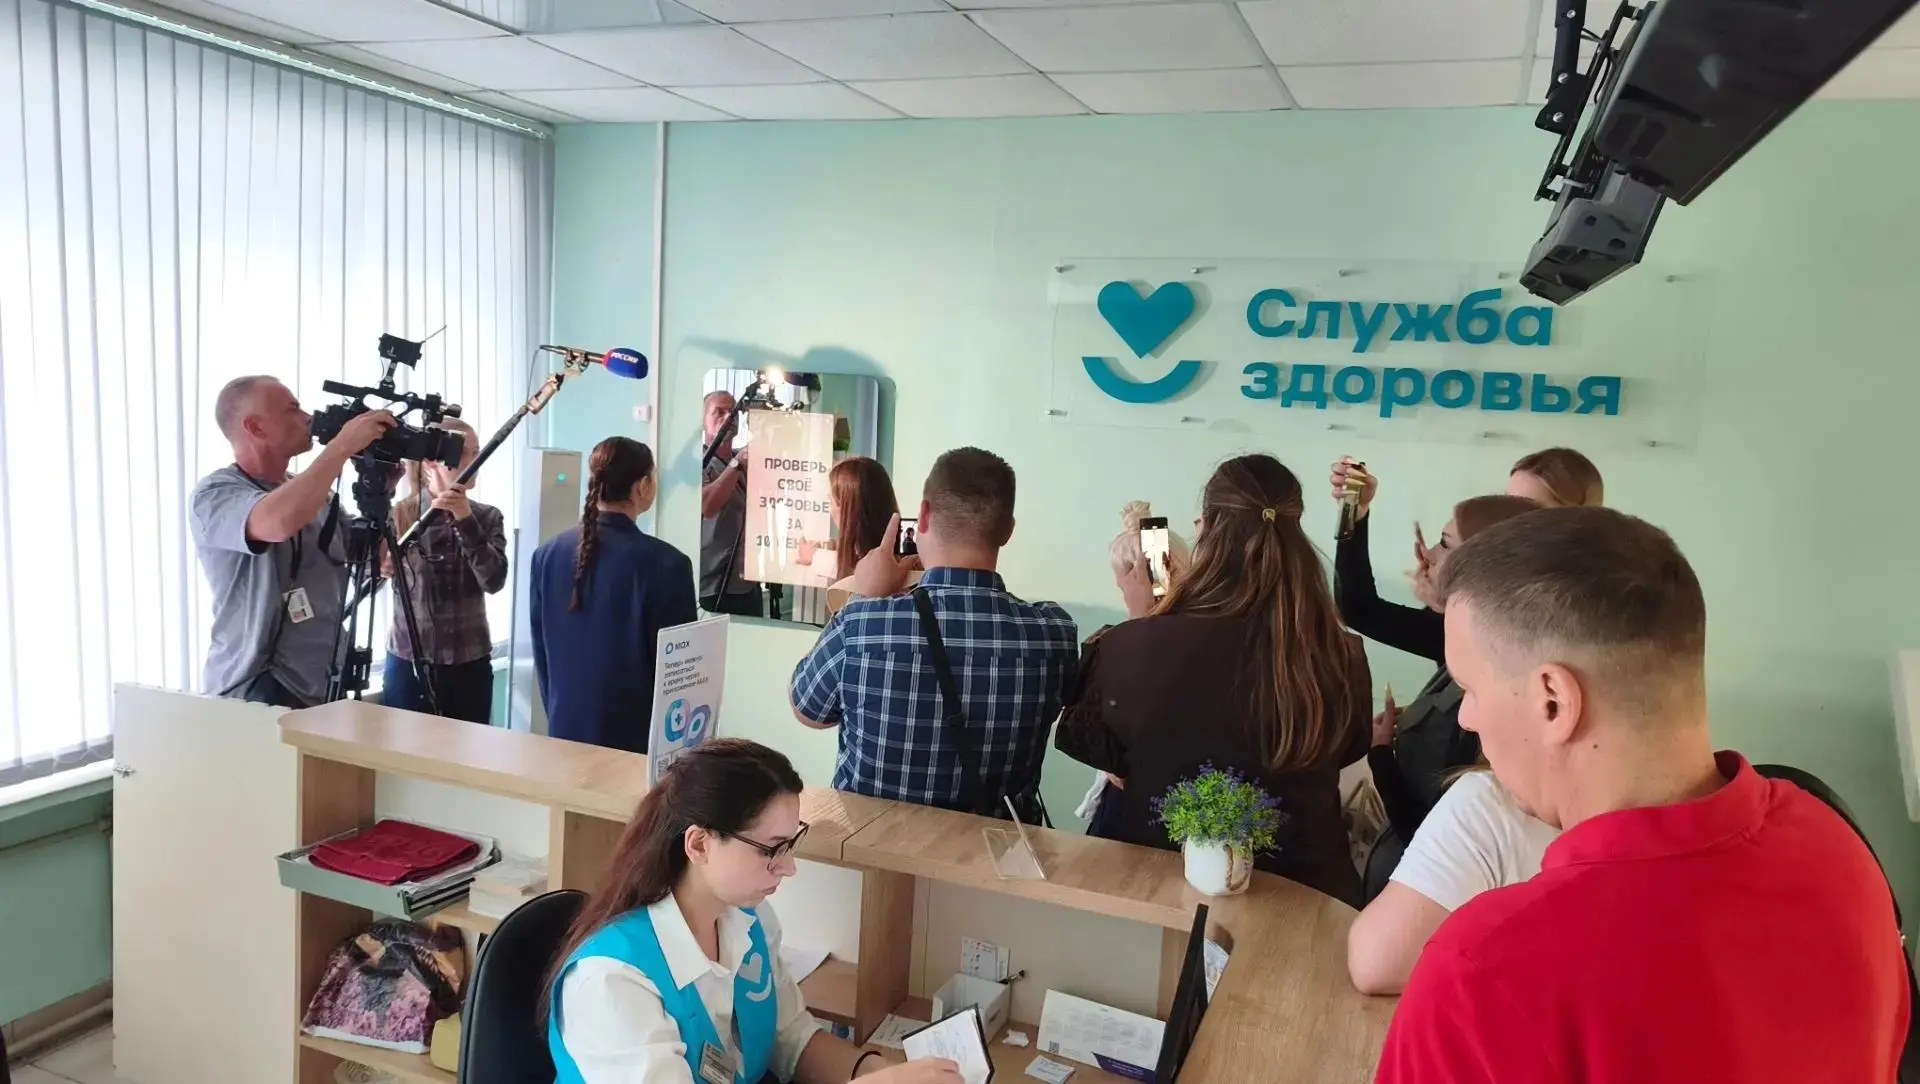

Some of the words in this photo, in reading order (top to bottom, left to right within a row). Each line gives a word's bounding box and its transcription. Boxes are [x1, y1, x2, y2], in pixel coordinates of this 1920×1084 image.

[1246, 287, 1555, 353] Служба
[1240, 360, 1622, 418] здоровья
[764, 457, 828, 474] ПРОВЕРЬ
[777, 477, 813, 492] СВОЁ
[786, 518, 803, 531] ЗА
